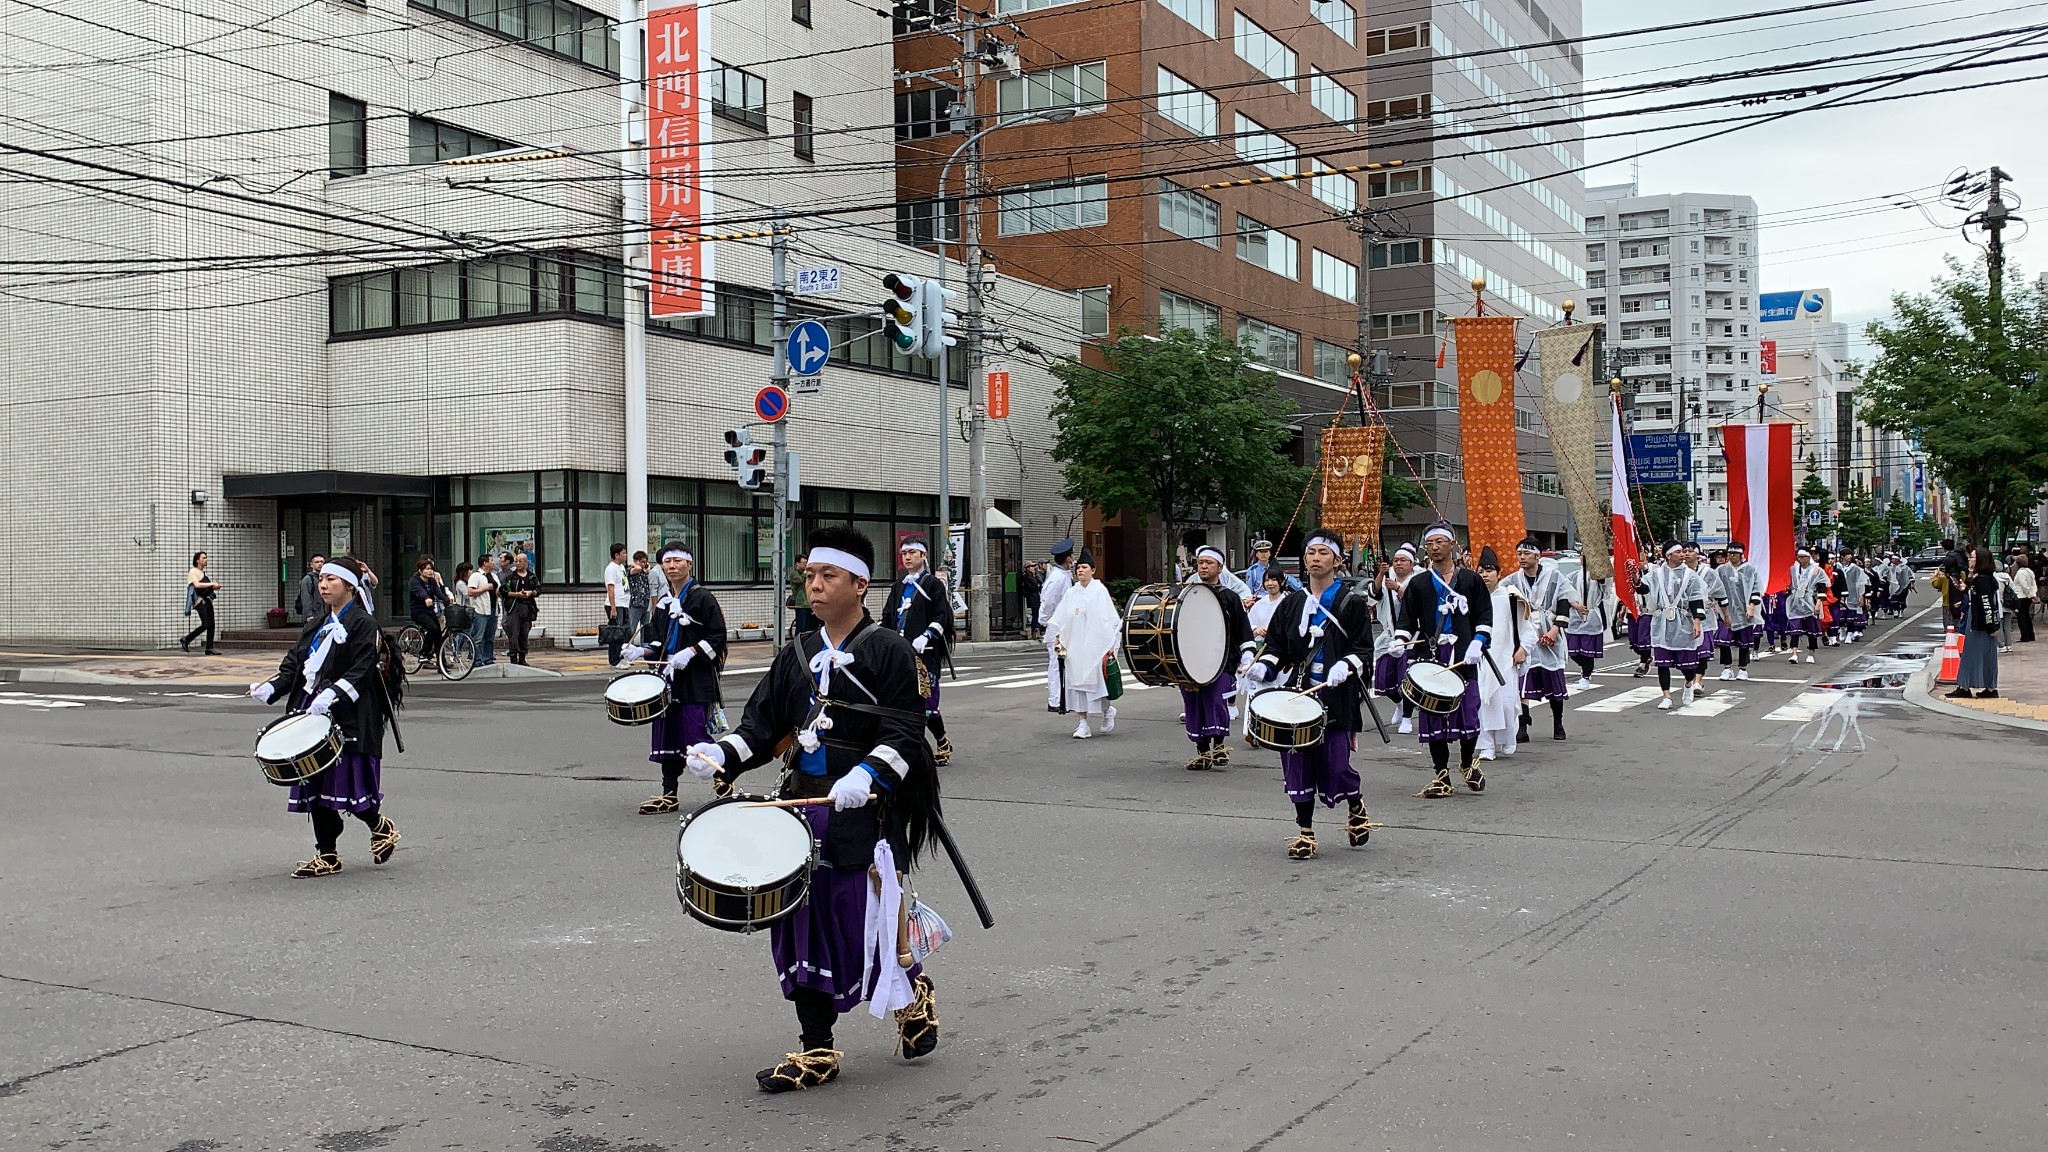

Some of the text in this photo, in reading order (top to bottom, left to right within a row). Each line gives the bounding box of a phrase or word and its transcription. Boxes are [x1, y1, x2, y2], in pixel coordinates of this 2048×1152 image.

[655, 21, 694, 299] 北門信用金庫
[799, 268, 838, 284] 南2東2
[815, 283, 819, 291] 2
[821, 282, 833, 290] East
[834, 281, 838, 289] 2
[1760, 307, 1794, 317] 新生銀行
